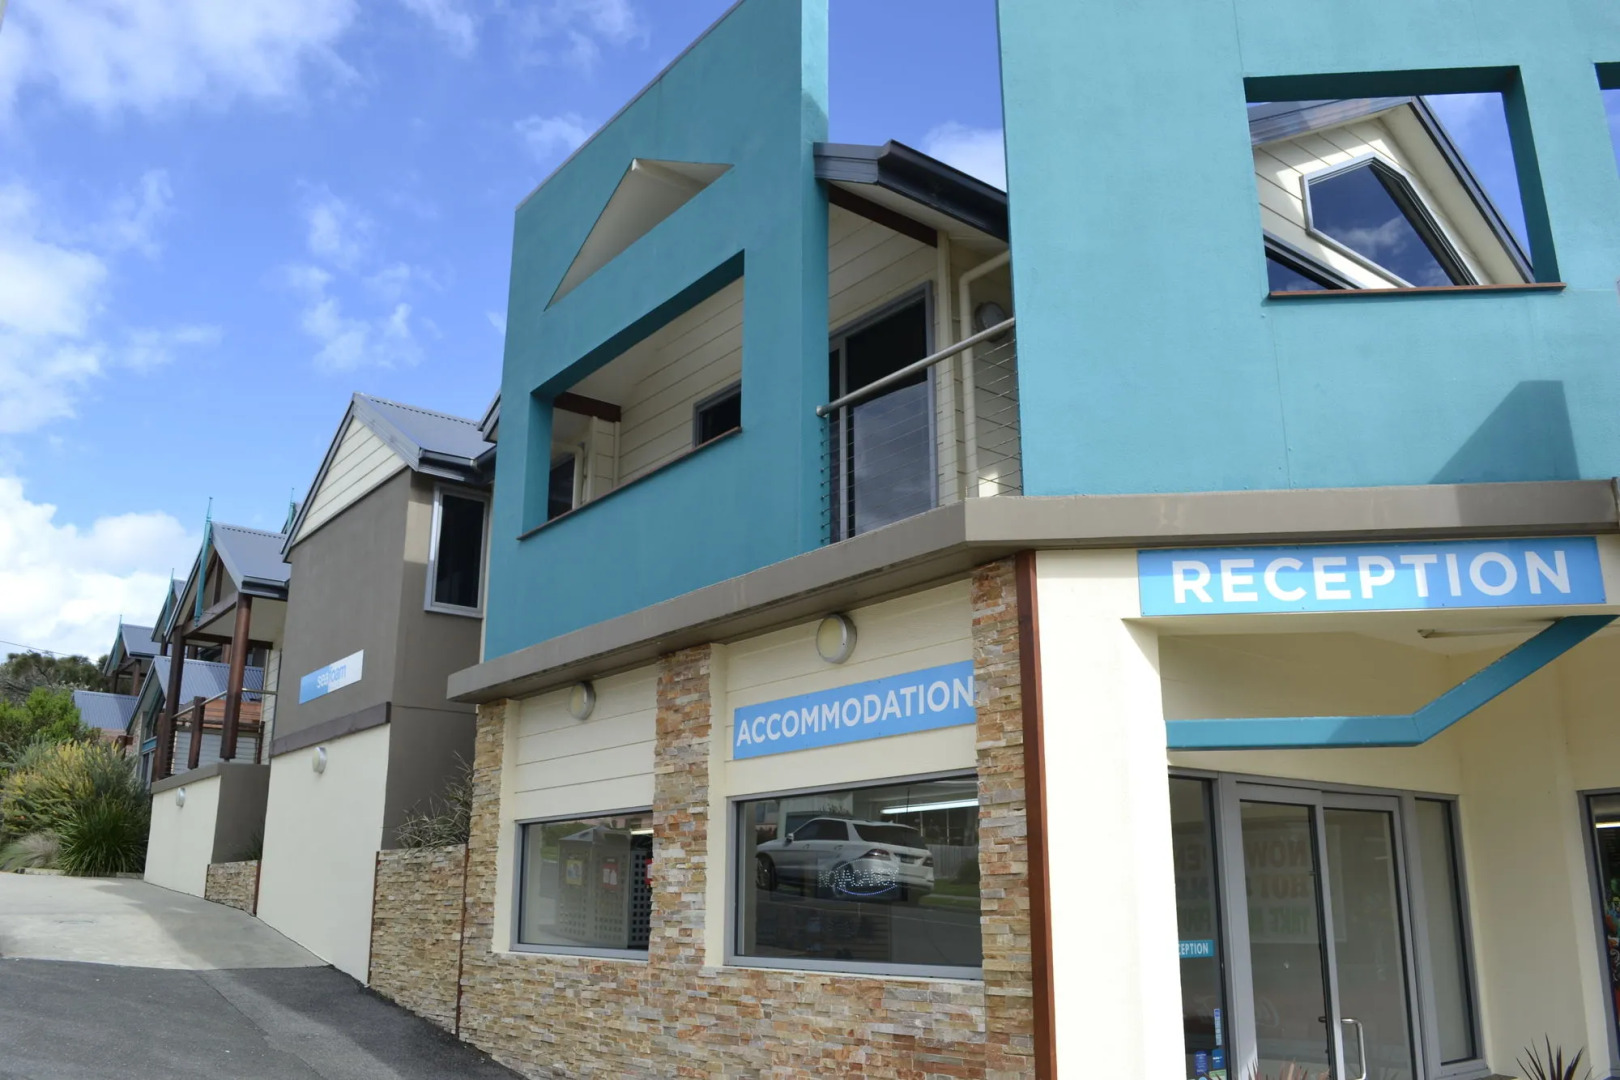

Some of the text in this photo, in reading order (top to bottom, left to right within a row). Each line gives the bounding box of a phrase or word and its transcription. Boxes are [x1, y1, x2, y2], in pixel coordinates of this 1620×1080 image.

[1172, 550, 1571, 604] RECEPTION
[736, 675, 974, 747] ACCOMMODATION
[1179, 942, 1209, 956] EPTION
